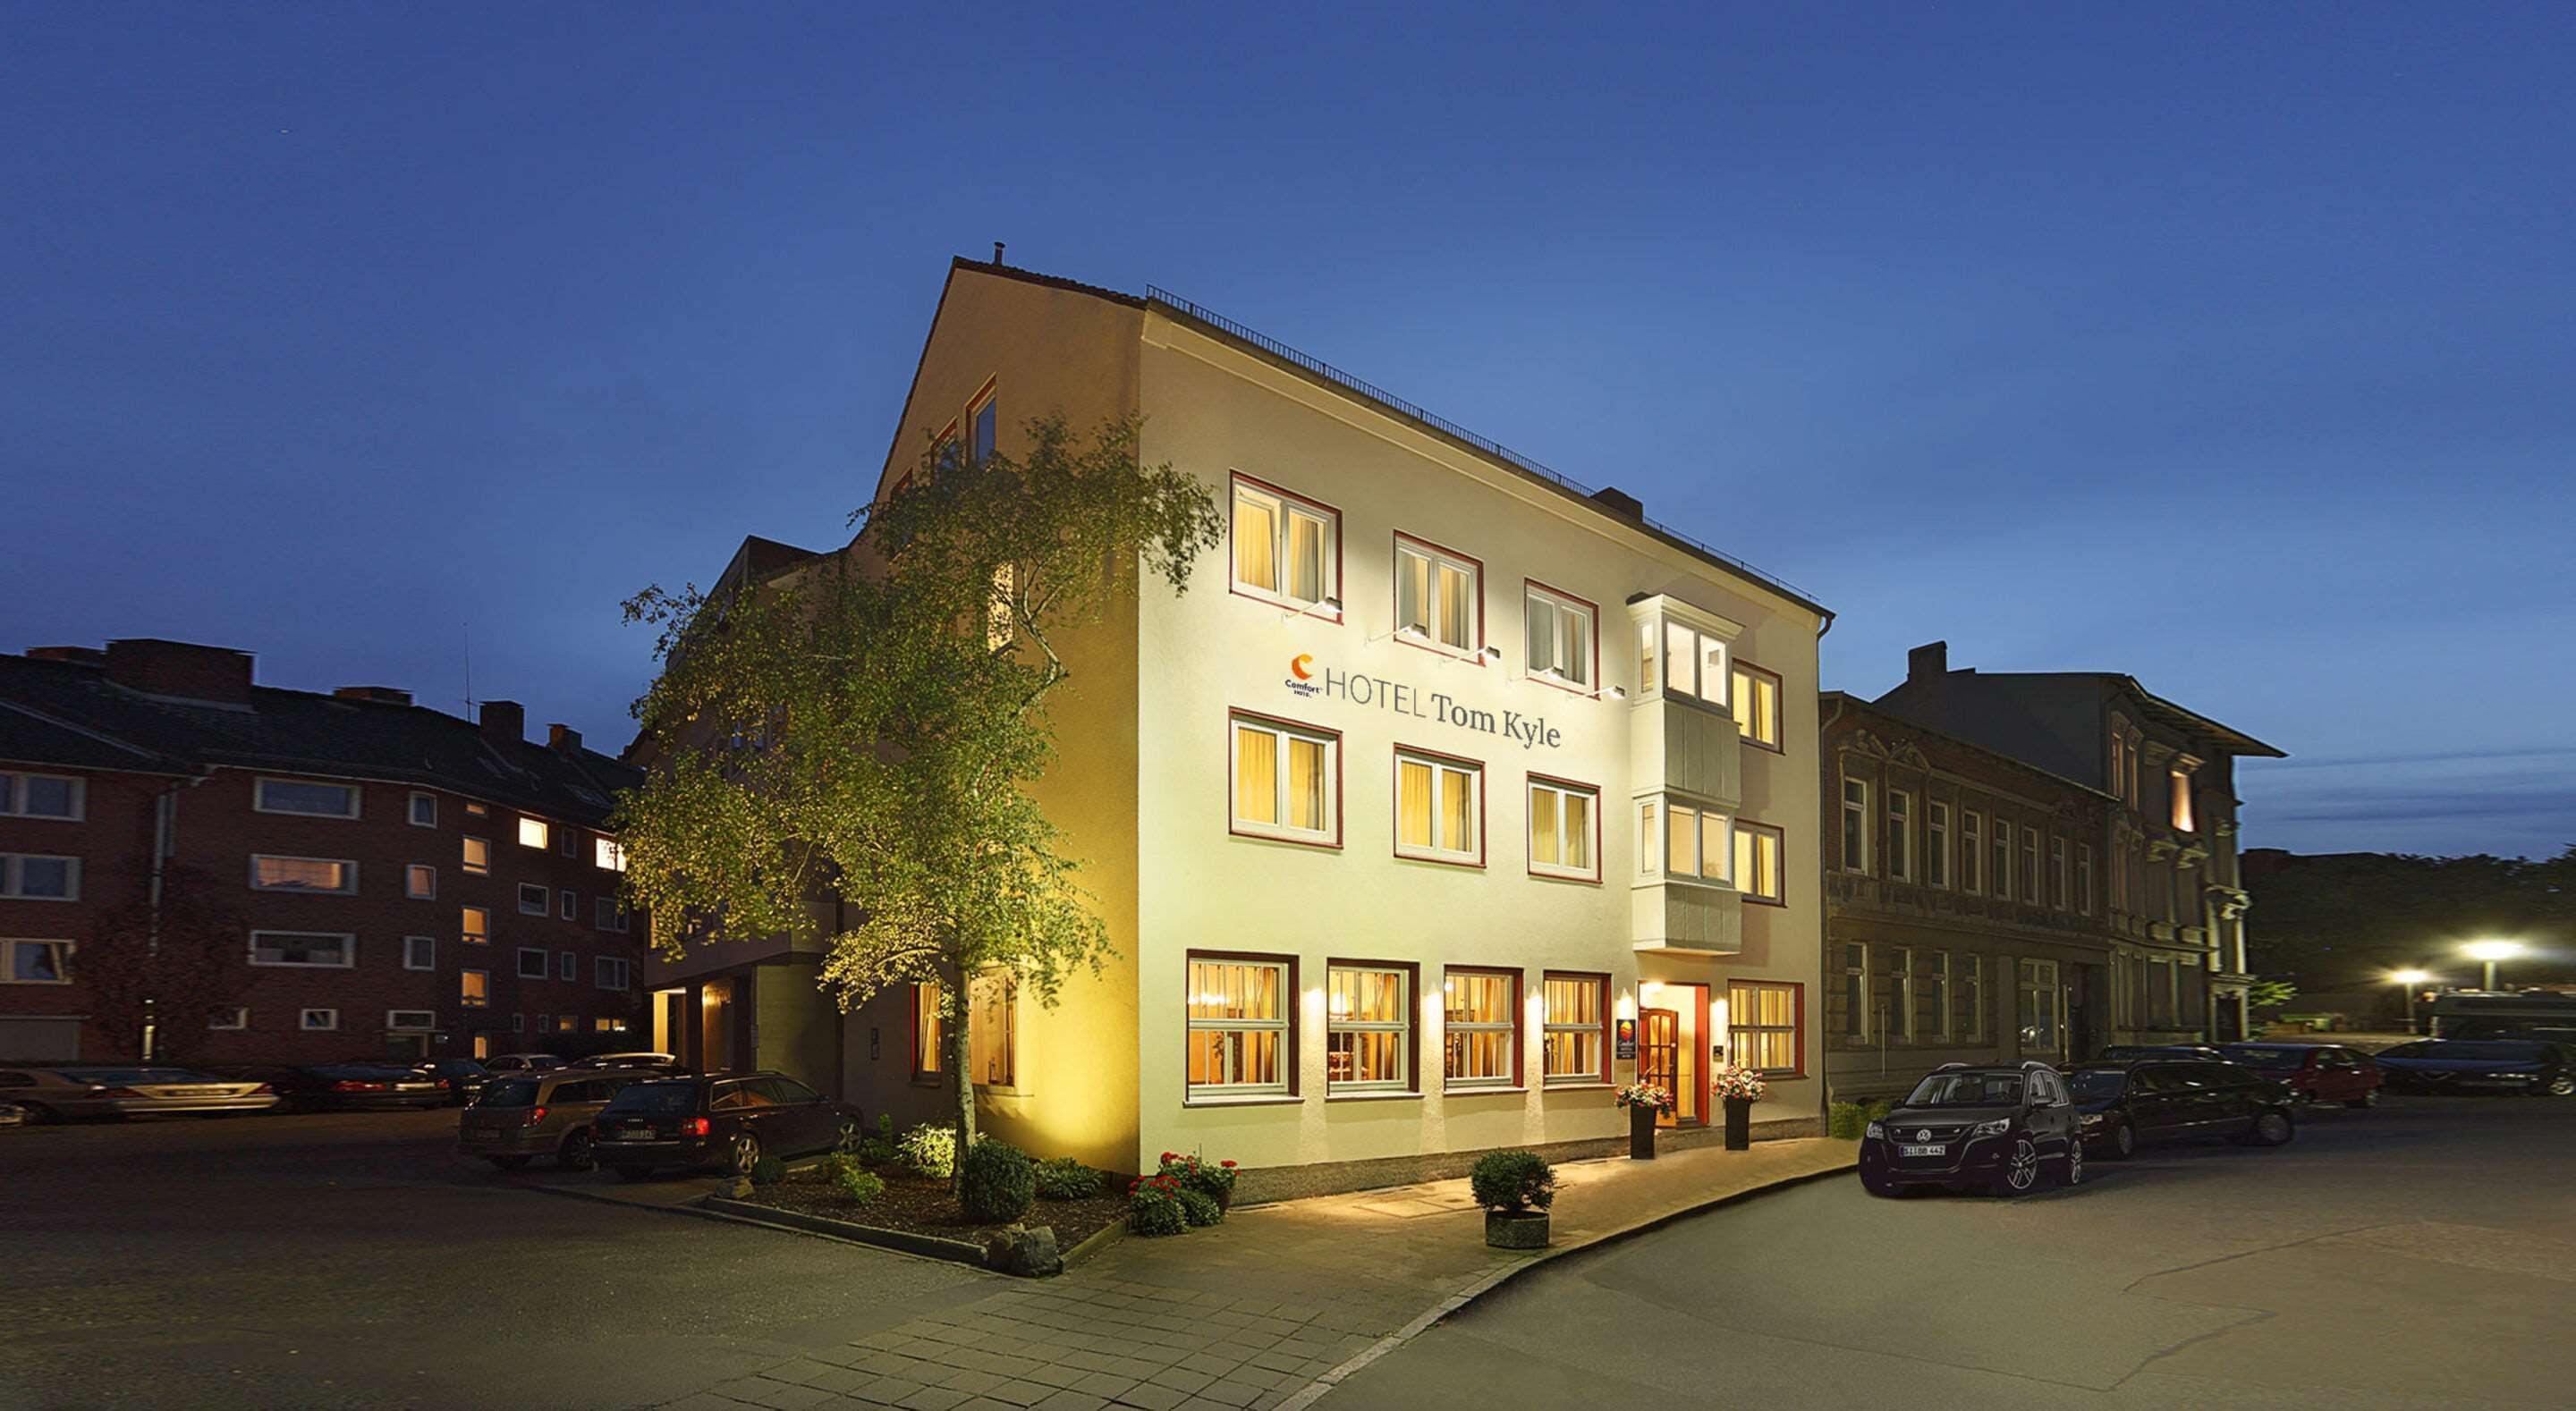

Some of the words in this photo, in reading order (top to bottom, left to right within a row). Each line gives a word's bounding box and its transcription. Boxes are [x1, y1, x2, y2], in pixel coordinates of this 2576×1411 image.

[1284, 679, 1320, 694] Comfort
[1326, 667, 1427, 718] HOTEL
[1431, 693, 1496, 734] Tom
[1502, 710, 1561, 749] Kyle
